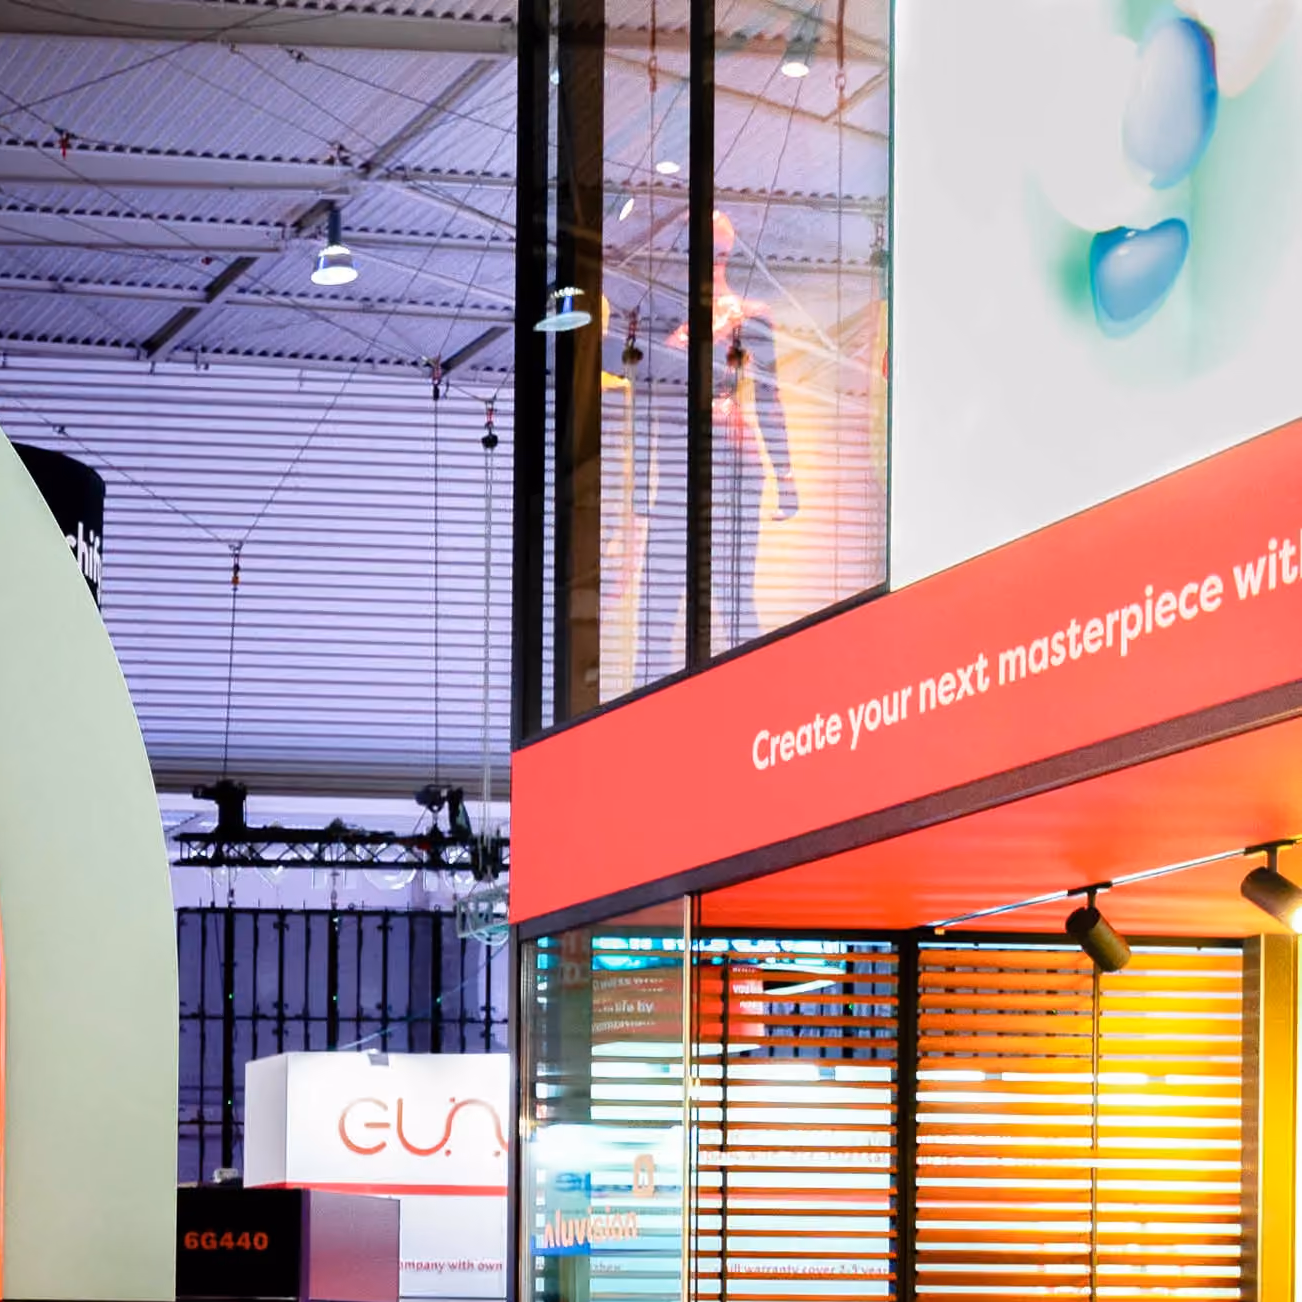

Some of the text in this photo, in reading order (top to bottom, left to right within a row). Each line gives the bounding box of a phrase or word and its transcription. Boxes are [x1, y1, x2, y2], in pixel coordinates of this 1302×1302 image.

[751, 712, 843, 771] Create
[848, 683, 913, 750] your
[918, 652, 990, 714] next
[998, 573, 1225, 687] masterpiece
[184, 1231, 269, 1250] 6G440
[448, 1259, 475, 1271] with
[477, 1261, 503, 1271] own
